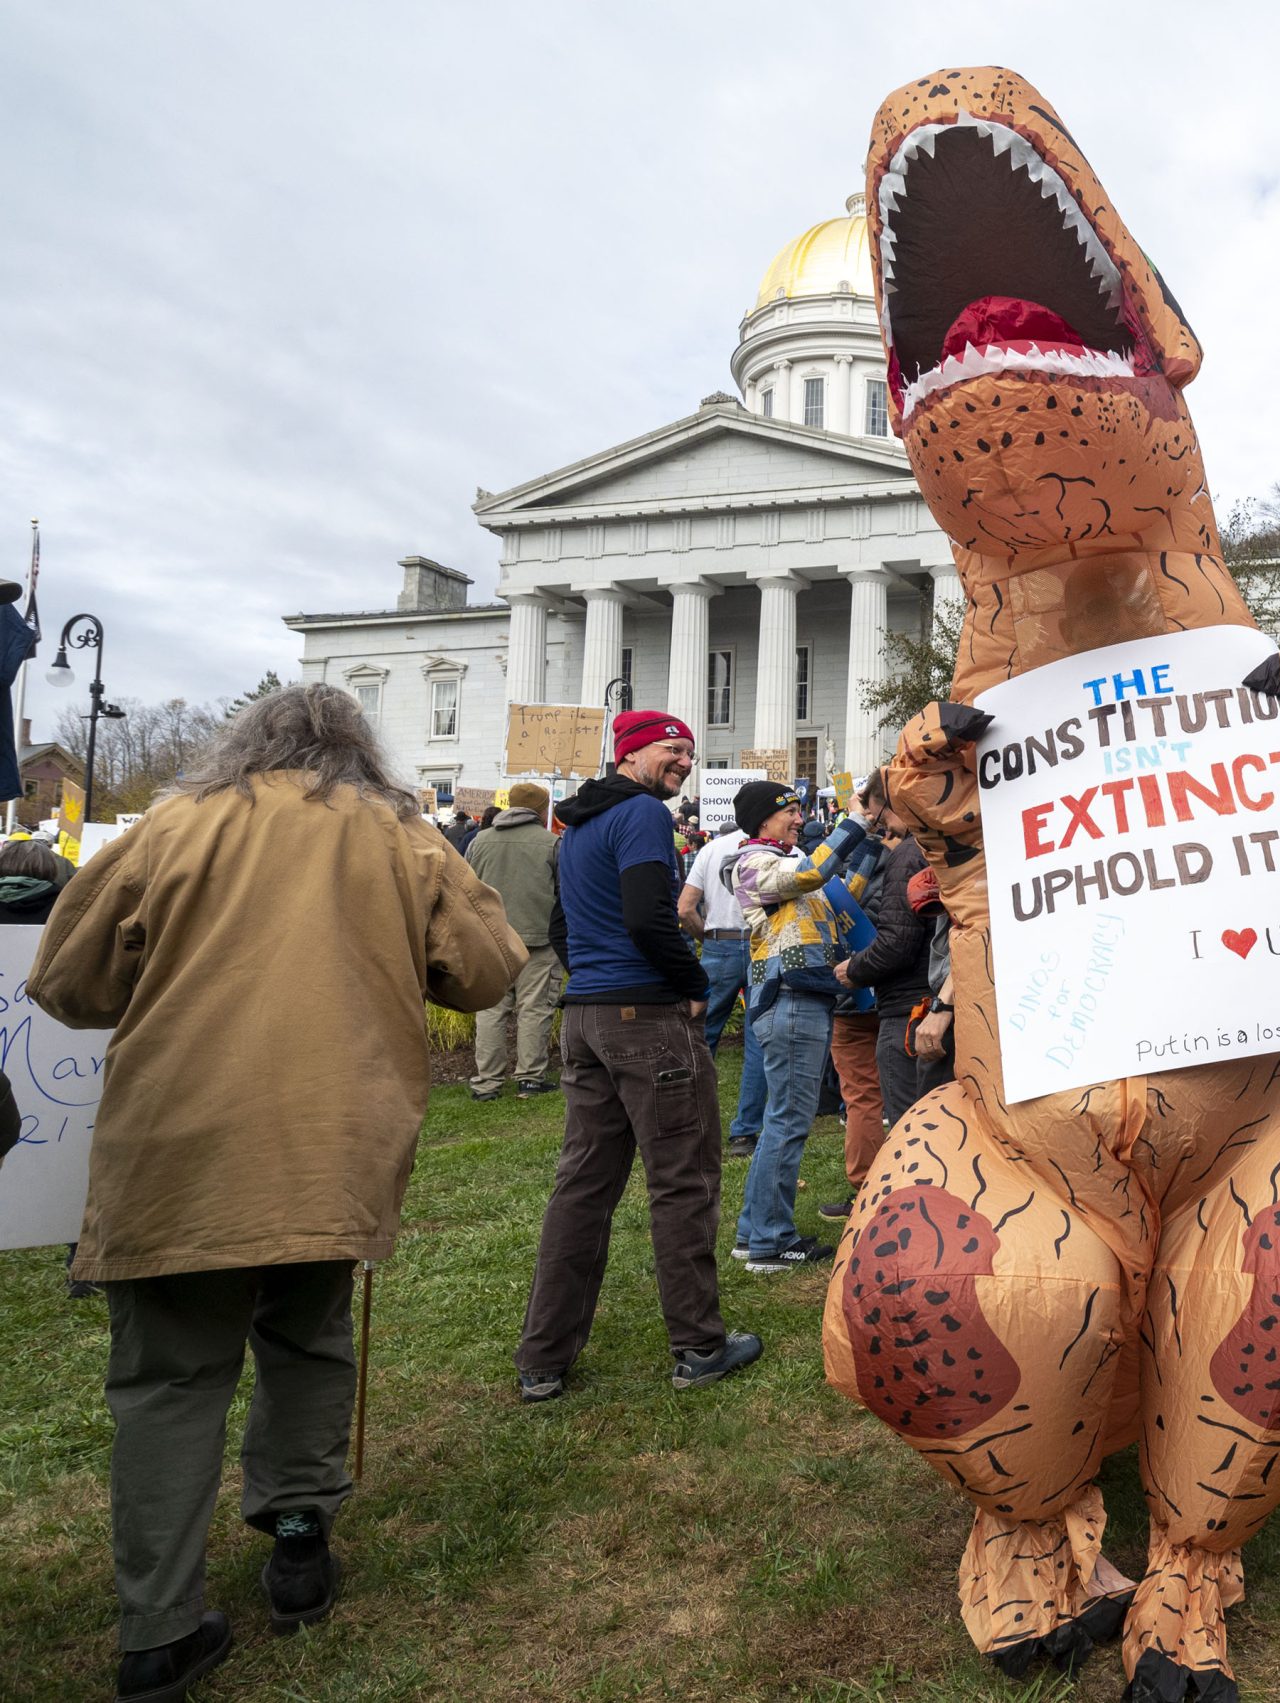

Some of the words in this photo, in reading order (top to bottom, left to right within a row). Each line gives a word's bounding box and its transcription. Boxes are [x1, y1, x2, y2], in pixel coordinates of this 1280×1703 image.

[1082, 664, 1174, 705] THE
[518, 705, 561, 725] Trump
[741, 760, 788, 771] DIRECT
[1103, 740, 1192, 775] ISN'T
[702, 797, 732, 806] SHOW
[706, 814, 735, 822] COUR
[1011, 842, 1213, 922] UPHOLD
[1188, 929, 1204, 960] I
[1135, 1036, 1209, 1061] Putin
[1217, 1027, 1231, 1047] is
